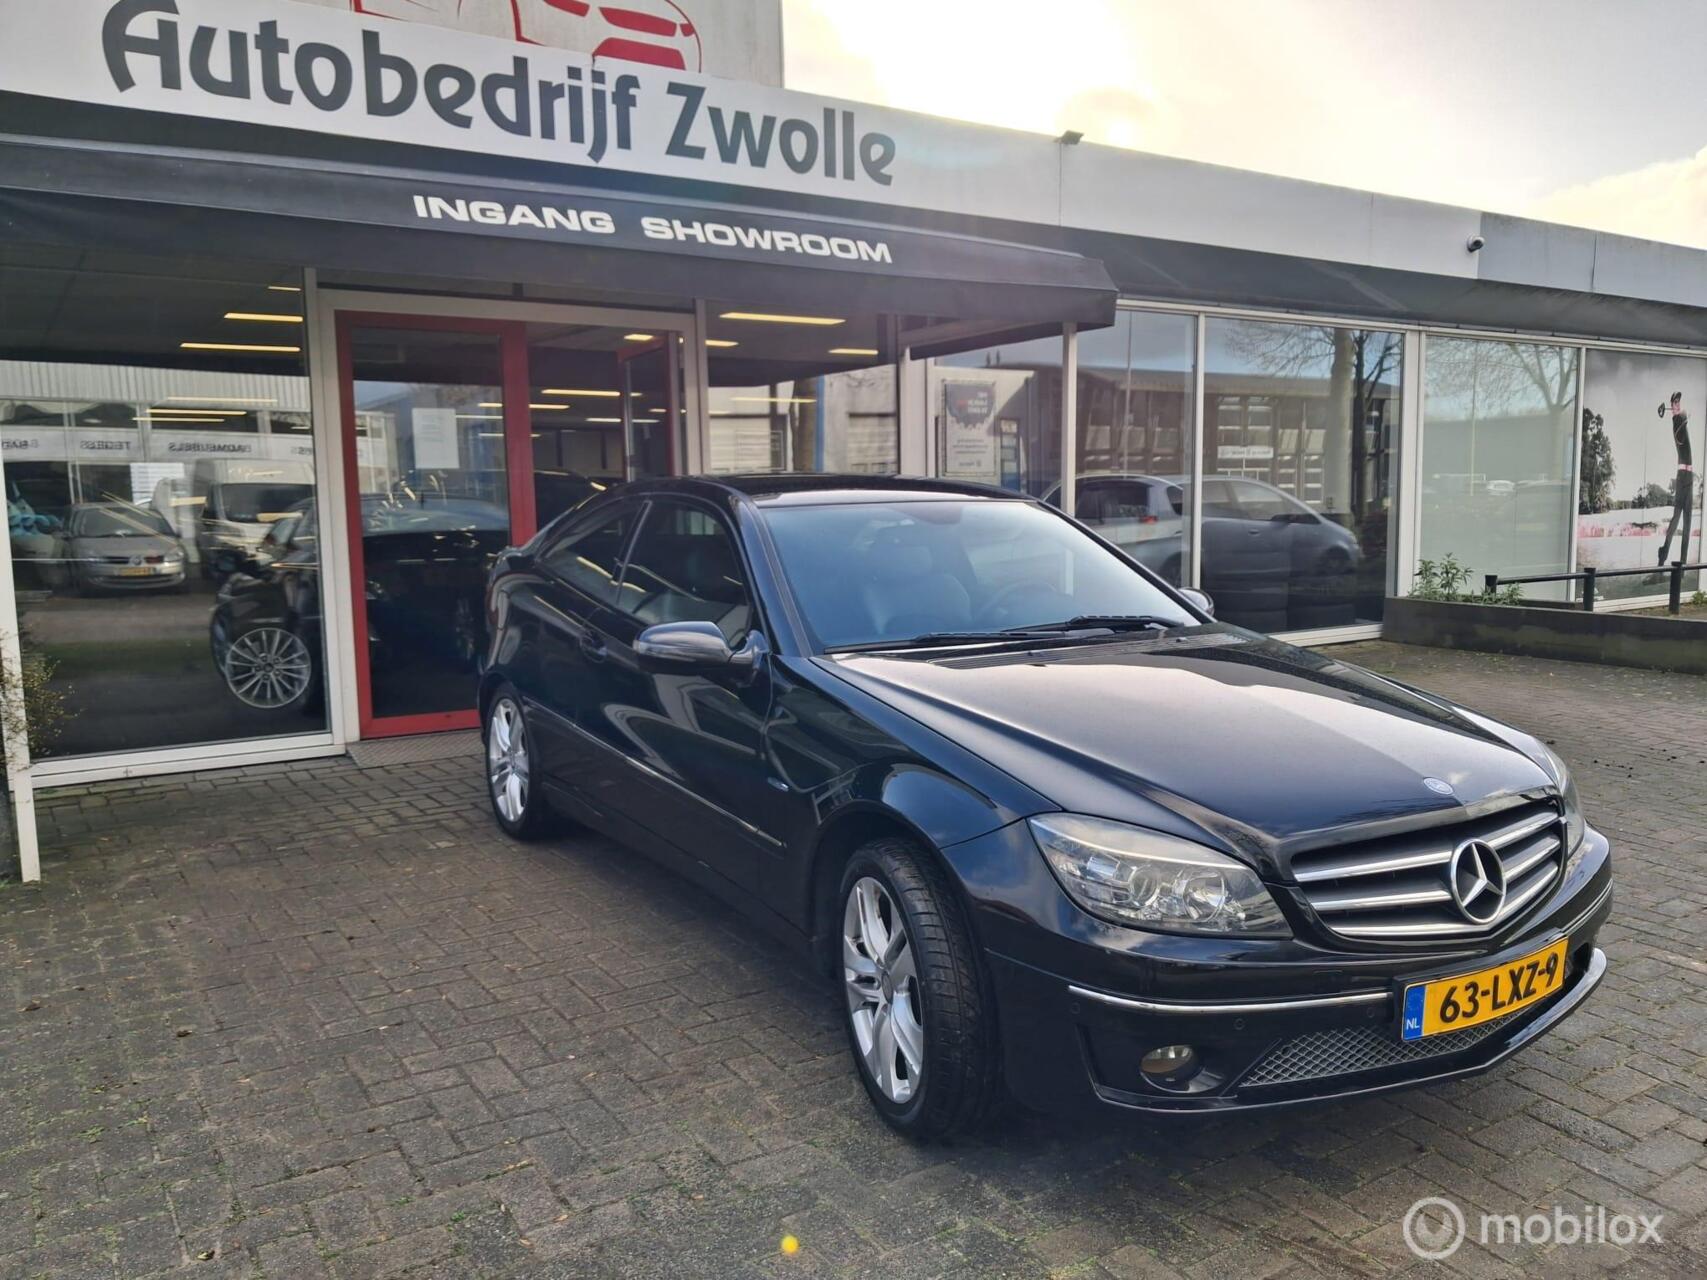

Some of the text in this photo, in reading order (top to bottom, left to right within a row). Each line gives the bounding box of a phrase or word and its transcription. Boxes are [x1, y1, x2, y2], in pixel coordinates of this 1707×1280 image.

[102, 0, 896, 186] Autobedrijf Zwolle
[413, 194, 893, 264] INGANG SHOWROOM
[1440, 951, 1559, 1024] 63-LXZ-9
[1405, 1018, 1420, 1030] NL
